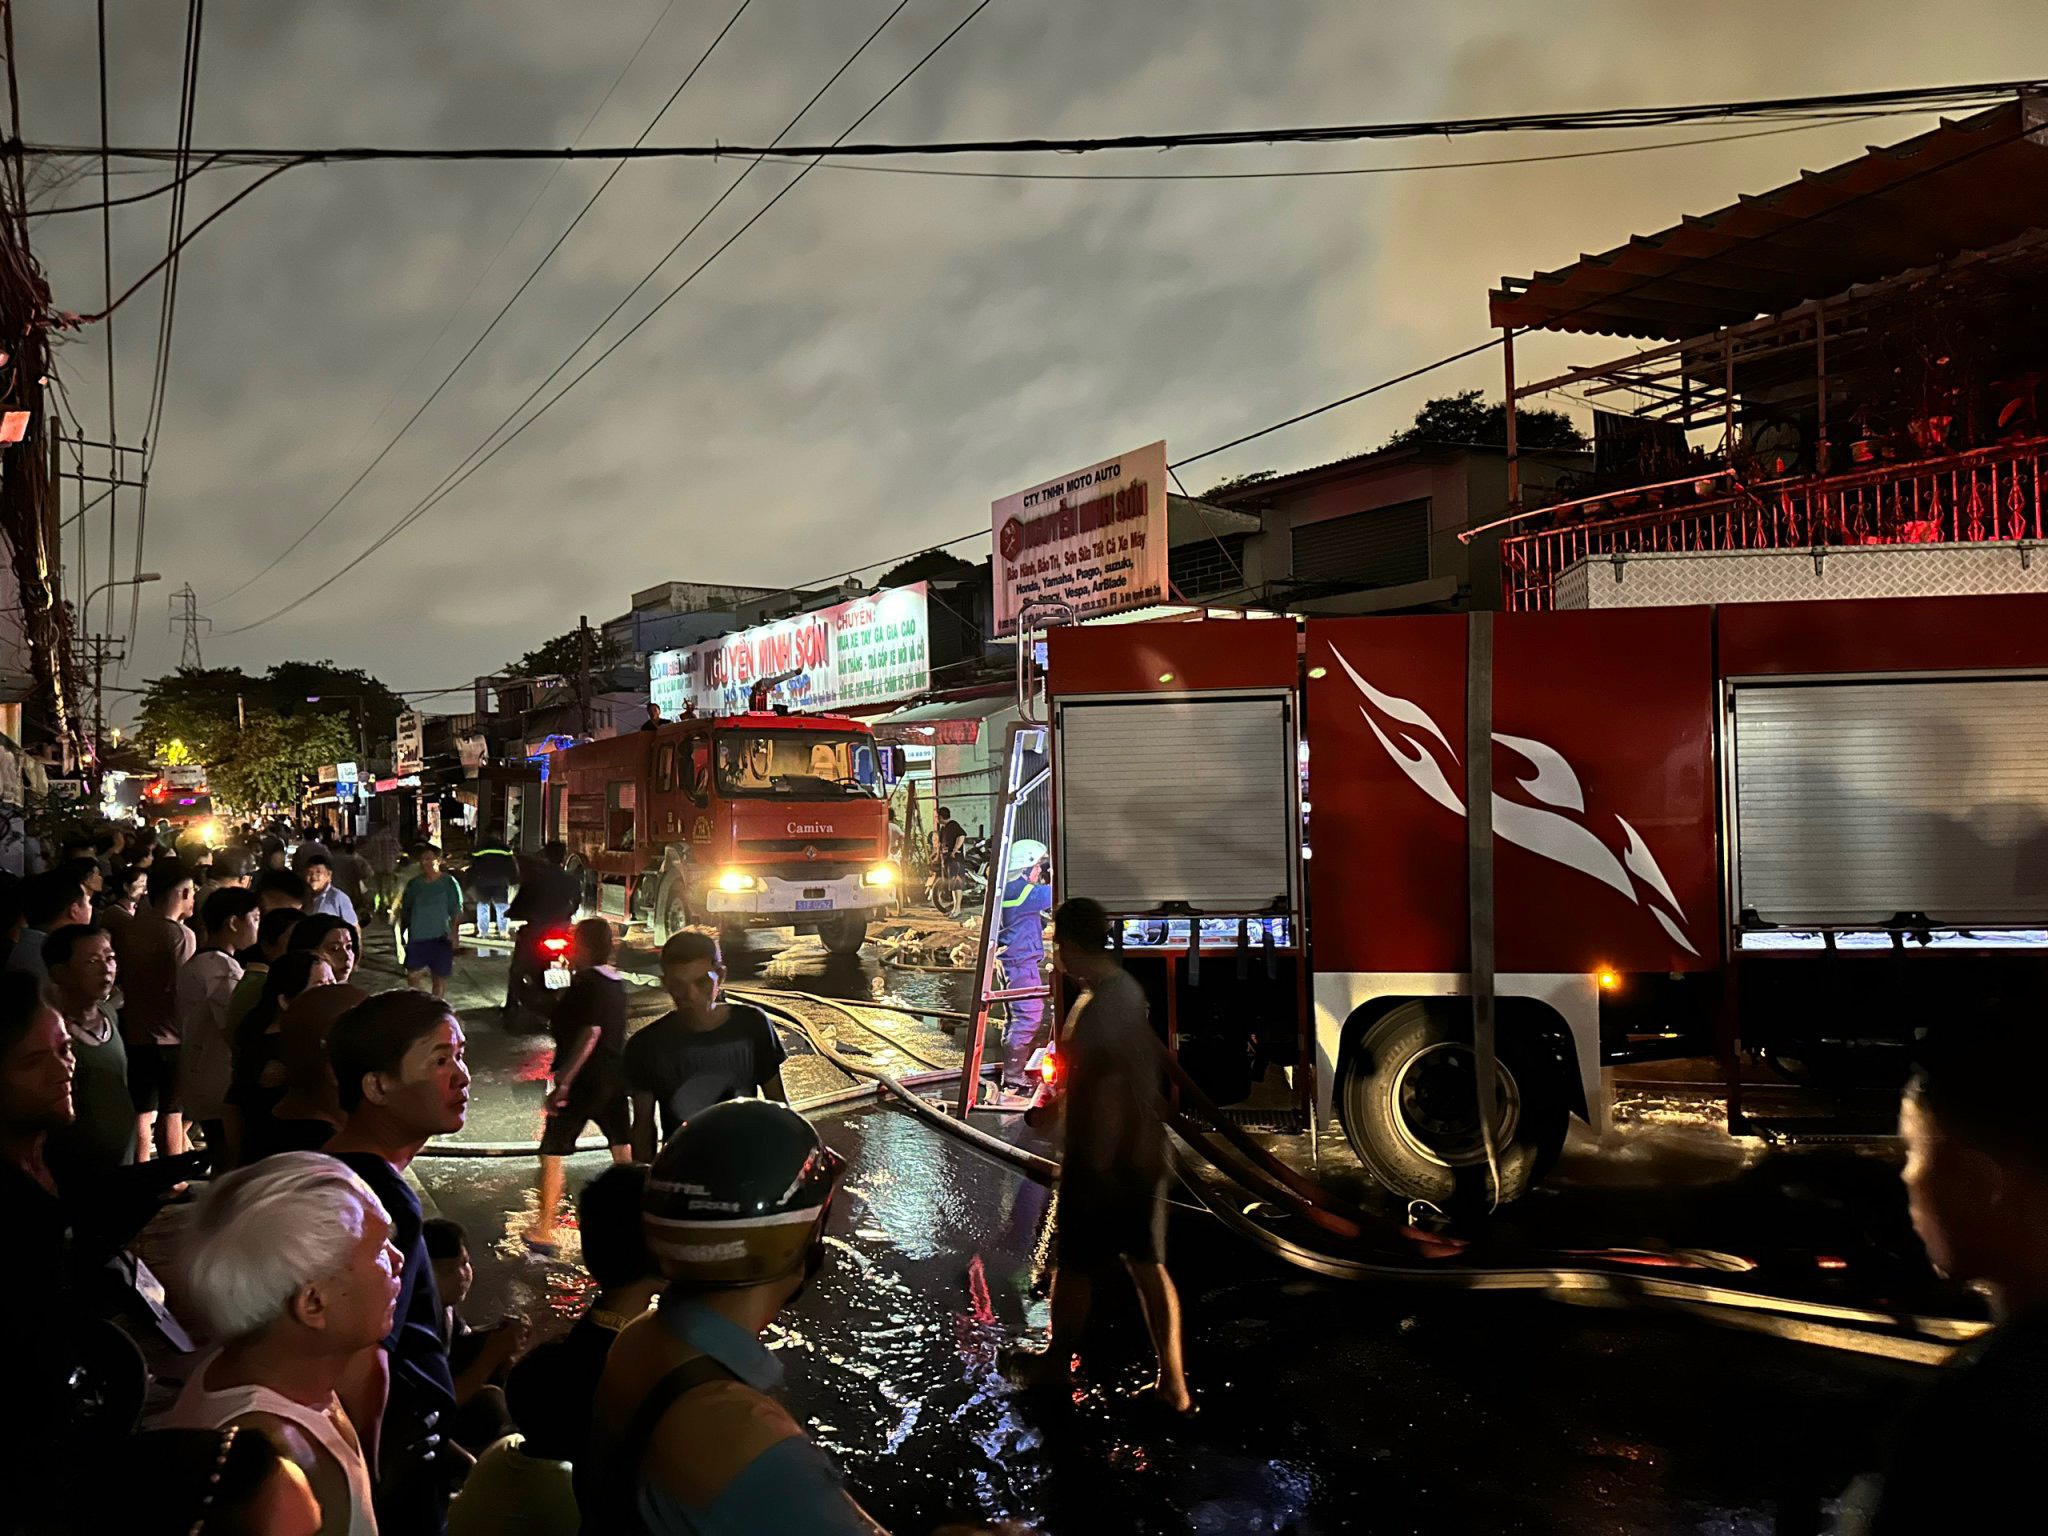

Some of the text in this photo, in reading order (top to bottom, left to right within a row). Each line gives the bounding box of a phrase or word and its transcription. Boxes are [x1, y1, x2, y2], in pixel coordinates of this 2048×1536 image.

[1023, 464, 1121, 508] CTY TNHH MOTO AUTO
[1117, 535, 1128, 551] Xe
[1016, 580, 1040, 595] Honda,
[1042, 573, 1074, 588] Yamaha,
[1065, 584, 1091, 599] Vespa,
[850, 632, 859, 648] XE
[861, 628, 872, 646] TAY
[874, 626, 884, 643] GA
[901, 618, 916, 637] CAO
[759, 632, 792, 680] MINH
[795, 615, 830, 671] SƠN
[787, 821, 833, 834] Camiva
